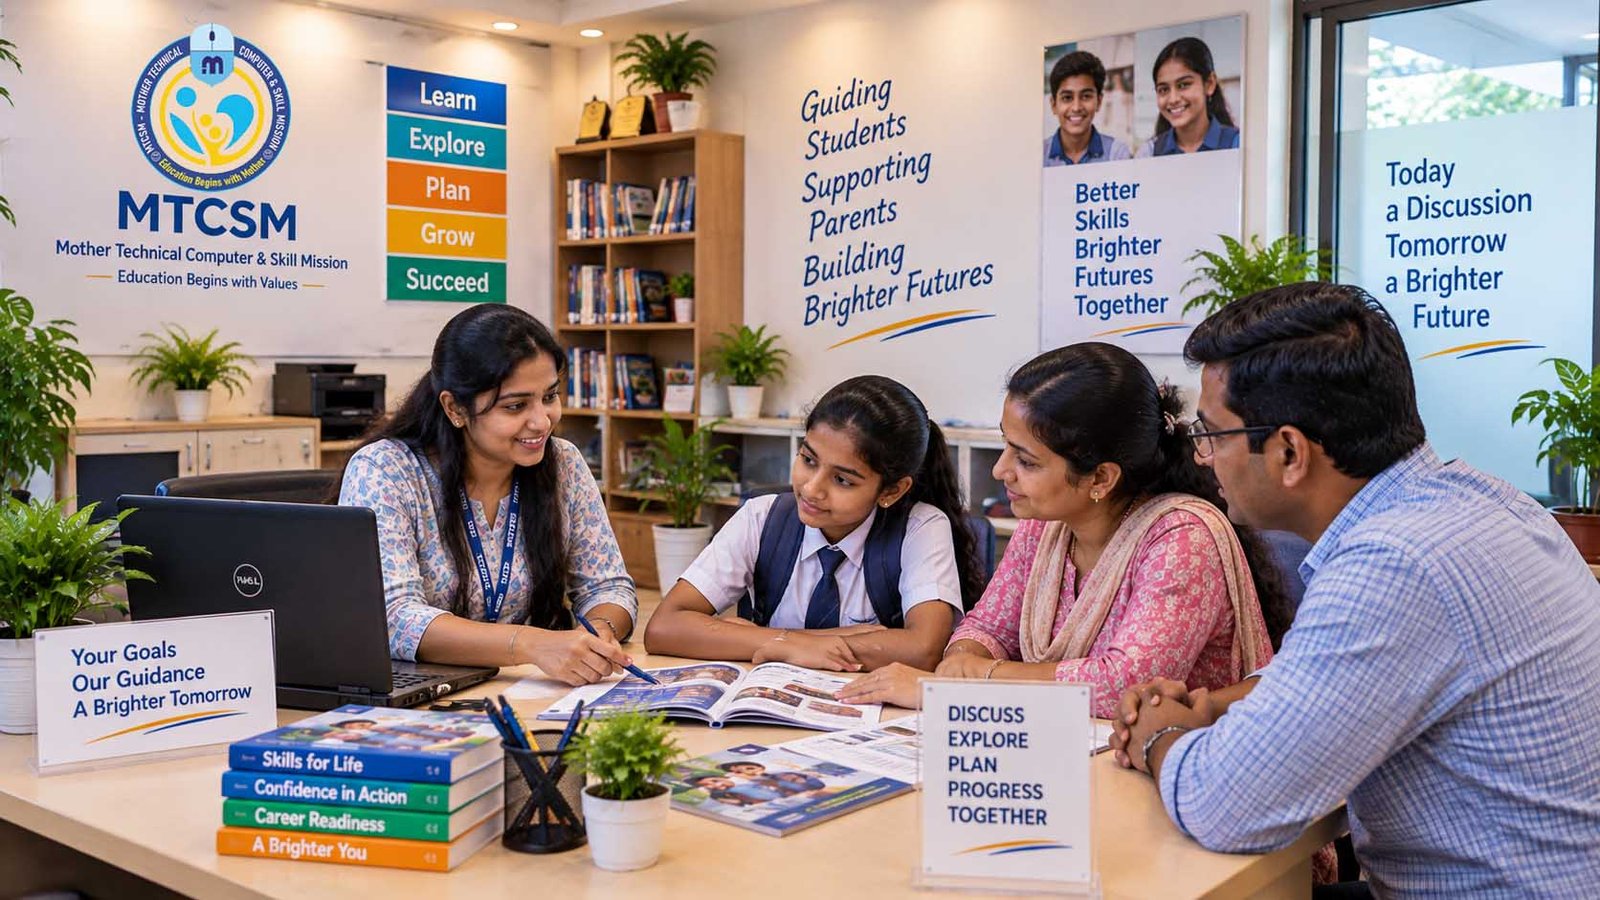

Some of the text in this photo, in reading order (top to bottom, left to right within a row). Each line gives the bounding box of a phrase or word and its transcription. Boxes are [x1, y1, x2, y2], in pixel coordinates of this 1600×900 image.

[148, 45, 183, 80] TECHNICAL
[239, 45, 274, 81] COMPUTER
[136, 78, 153, 113] MOTHER
[272, 87, 285, 111] SKILL
[420, 82, 477, 111] Learn
[801, 77, 892, 124] Guiding
[136, 122, 155, 154] MTCSM
[269, 115, 286, 151] MISSION
[409, 127, 486, 158] Explore
[804, 112, 907, 160] Students
[159, 157, 266, 189] Education Begins with Mother
[801, 151, 932, 206] Supporting
[1386, 157, 1456, 189] Today
[426, 175, 471, 202] Plan
[1075, 181, 1140, 204] Better
[118, 190, 297, 241] MTCSM
[1075, 206, 1129, 232] Skills
[1386, 188, 1532, 222] a Discussion
[420, 222, 475, 248] Grow
[808, 198, 897, 243] Parents
[56, 240, 348, 270] Mother Technical Computer & Skill Mission
[1075, 234, 1162, 264] Brighter
[1386, 233, 1507, 259] Tomorrow
[803, 240, 905, 288] Building
[1075, 266, 1154, 288] Futures
[118, 269, 298, 290] Education Begins with Values
[406, 268, 489, 294] Succeed
[1385, 265, 1504, 298] a Brighter
[803, 263, 994, 328] Brighter Futures
[1074, 292, 1169, 321] Together
[1413, 303, 1490, 329] Future
[71, 640, 177, 667] Your Goals
[72, 666, 205, 693] Our Guidance
[72, 686, 252, 719] A Brighter Tomorrow
[948, 705, 1025, 724] DISCUSS
[948, 730, 1029, 749] EXPLORE
[262, 750, 364, 774] Skills for Life
[948, 755, 997, 773] PLAN
[254, 778, 338, 799] Confidence
[341, 784, 356, 801] in
[358, 785, 408, 805] Action
[948, 780, 1044, 800] PROGRESS
[254, 807, 386, 832] Career Readiness
[948, 805, 1047, 826] TOGETHER
[252, 836, 368, 861] A Brighter You
